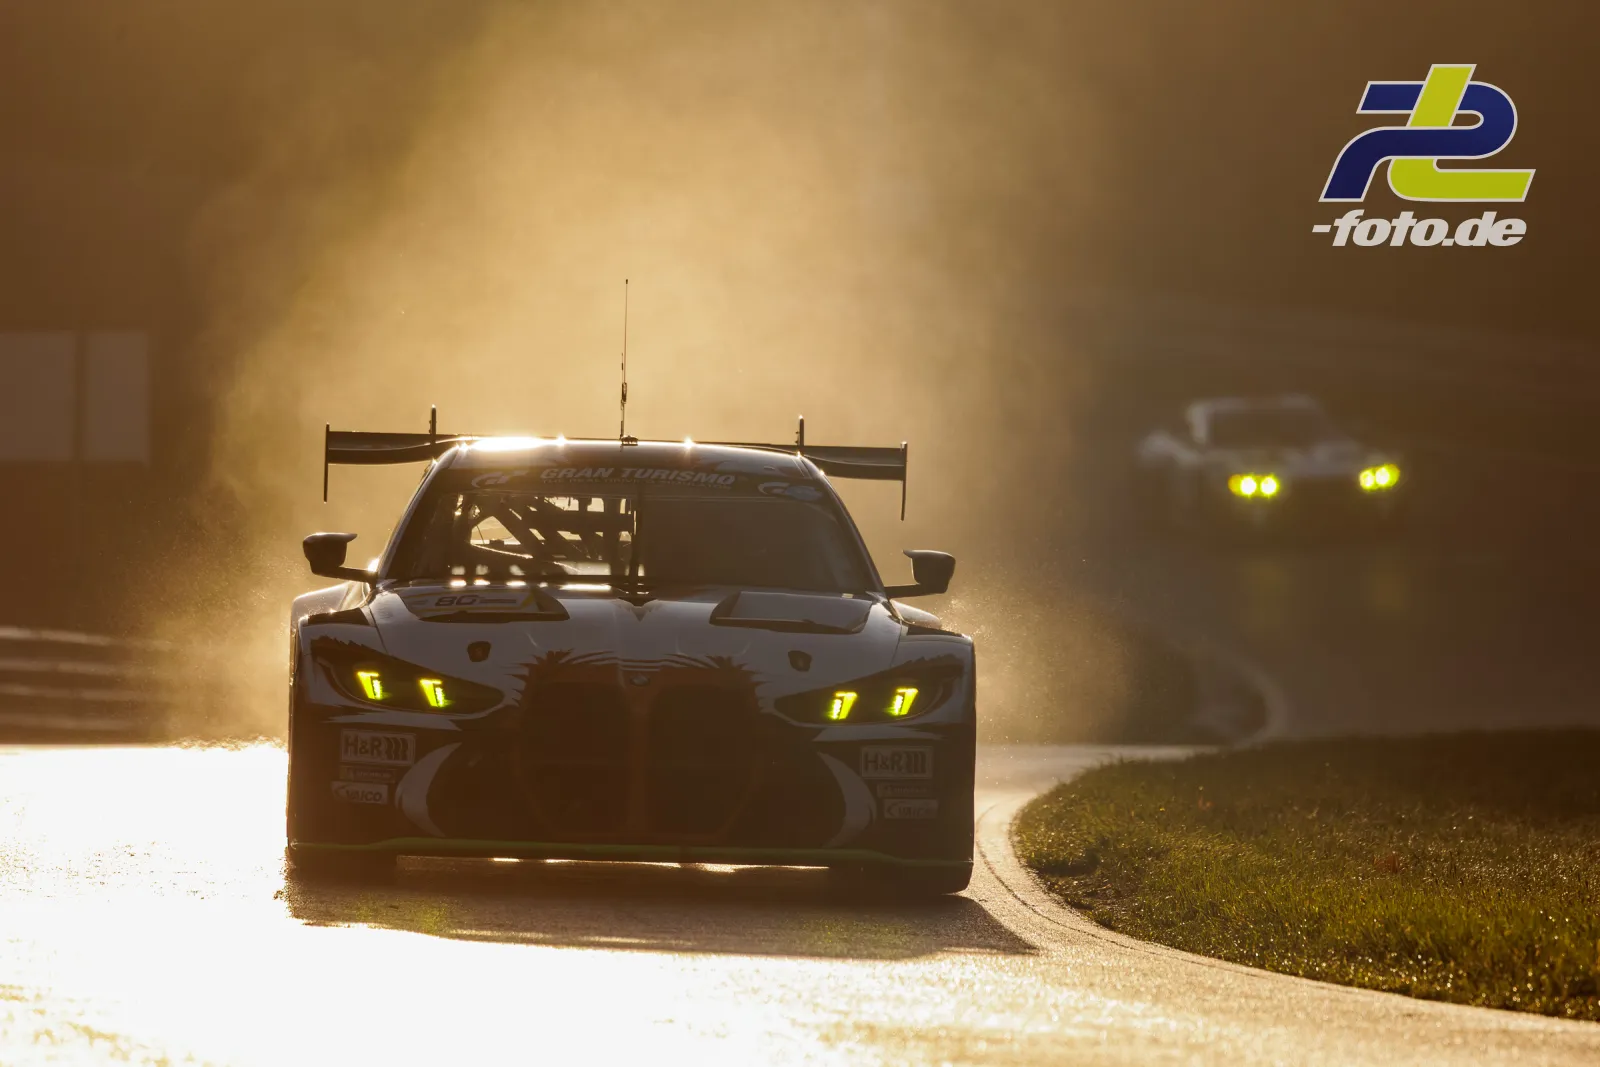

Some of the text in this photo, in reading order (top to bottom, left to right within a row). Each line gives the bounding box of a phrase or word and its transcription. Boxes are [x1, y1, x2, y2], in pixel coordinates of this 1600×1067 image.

[540, 467, 736, 485] GRAN TURISMO
[435, 595, 479, 608] 80
[344, 733, 382, 757] H&R
[864, 752, 902, 772] H&R
